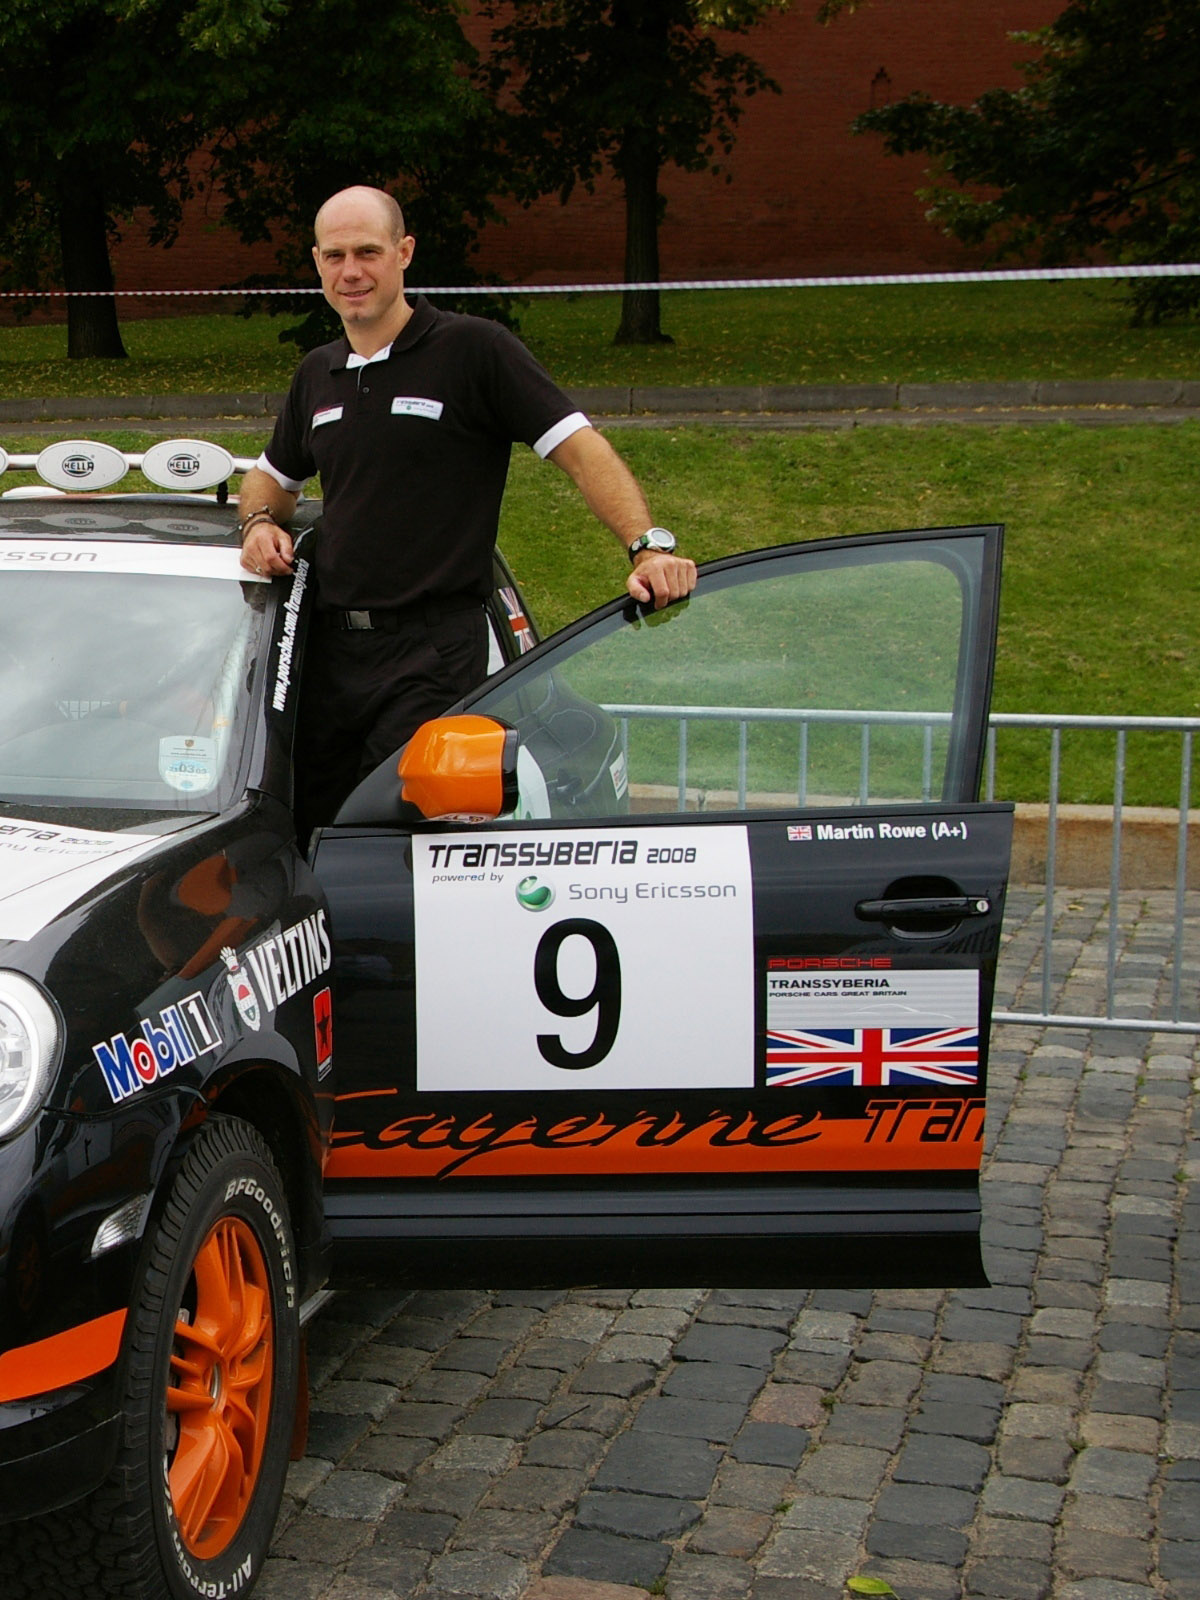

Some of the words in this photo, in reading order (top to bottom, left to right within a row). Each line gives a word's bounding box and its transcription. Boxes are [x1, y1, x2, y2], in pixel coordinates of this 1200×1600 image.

[64, 458, 94, 477] HELLA
[168, 458, 200, 476] HELLA
[272, 557, 310, 712] www.porsche.com/transsyberia
[816, 824, 875, 840] Martin
[879, 823, 927, 839] Rowe
[931, 821, 968, 841] (A+)
[428, 840, 639, 868] Transsyberia
[646, 847, 697, 864] 2008
[432, 873, 486, 884] powered
[490, 872, 504, 883] by
[568, 883, 629, 904] Sony
[635, 882, 737, 899] Ericsson
[245, 908, 332, 1013] VELTINS
[768, 957, 893, 970] PORSCHE
[534, 917, 622, 1070] 9
[769, 978, 891, 989] TRANSSYBERIA
[92, 1004, 197, 1104] Mobil
[224, 1178, 295, 1308] BFGoodrich
